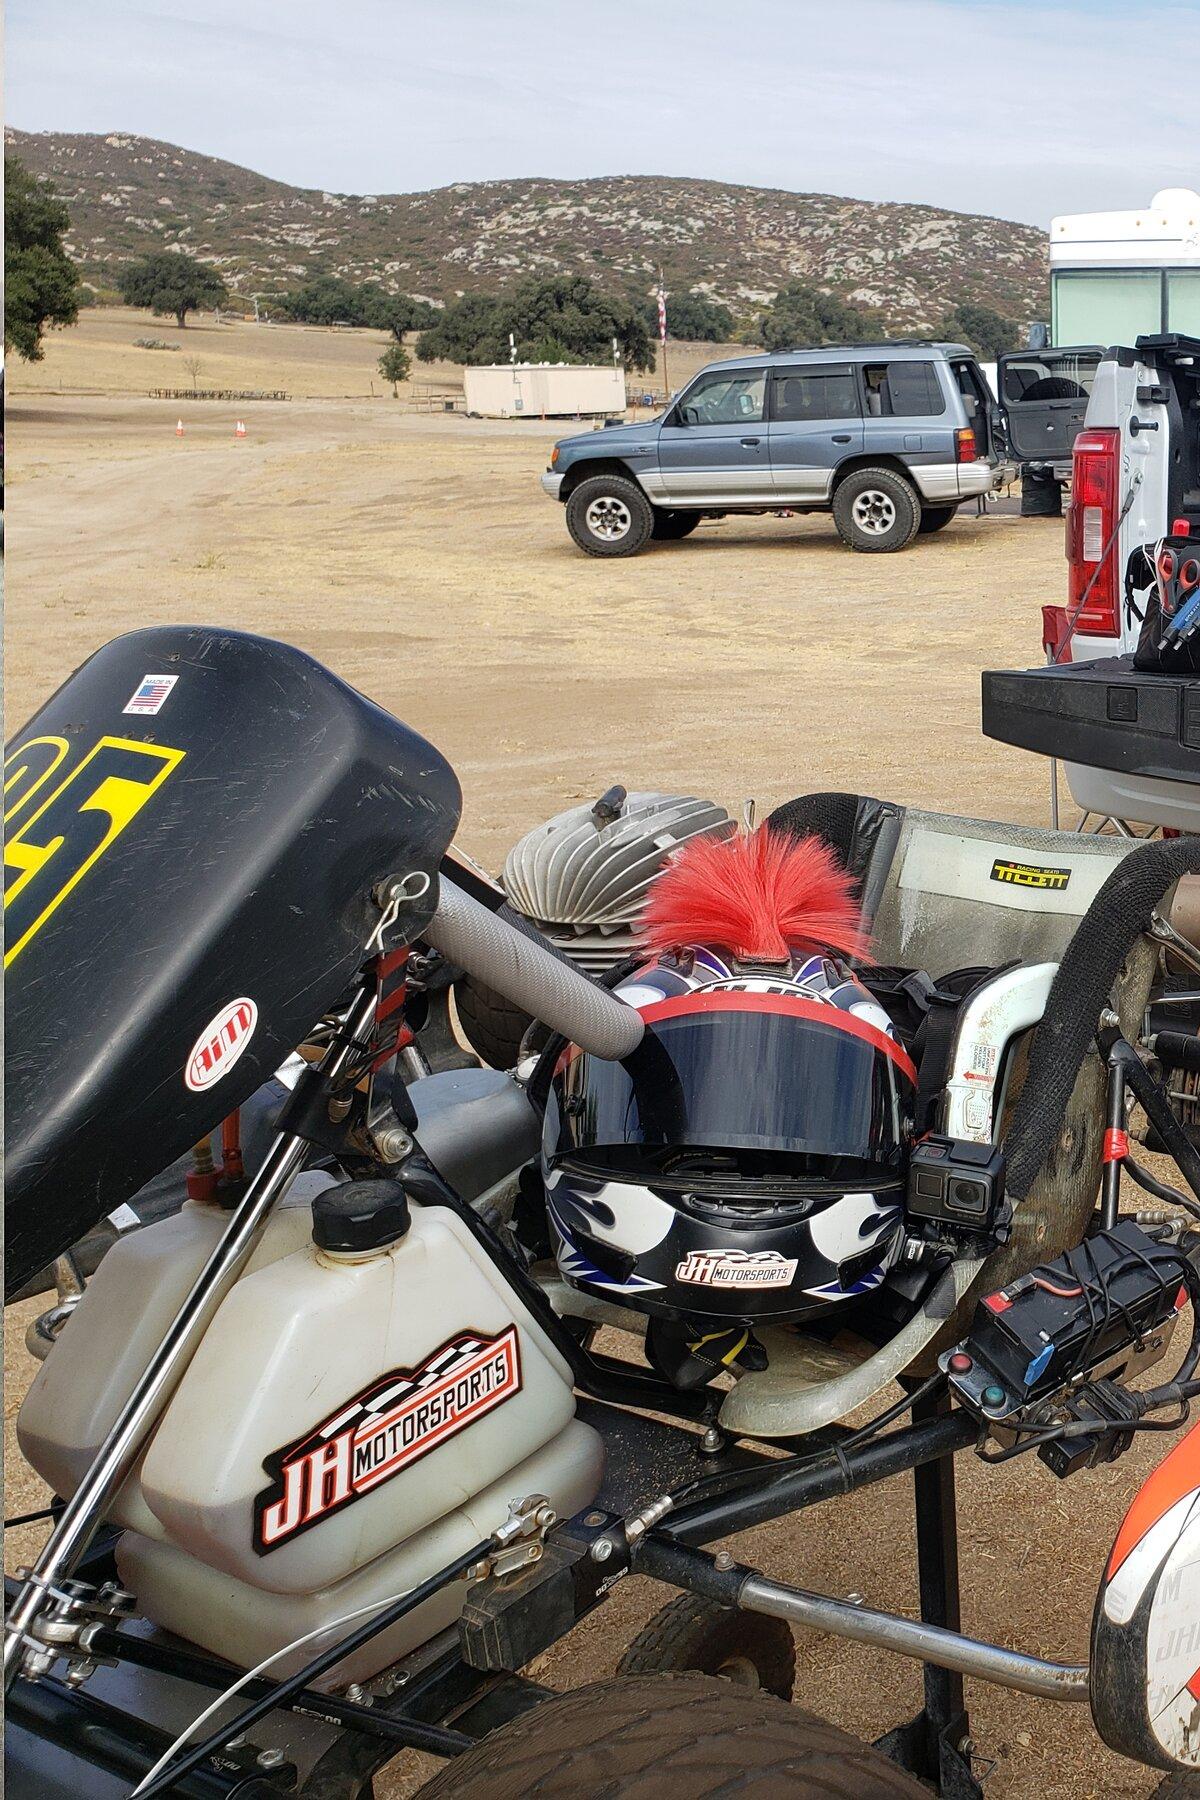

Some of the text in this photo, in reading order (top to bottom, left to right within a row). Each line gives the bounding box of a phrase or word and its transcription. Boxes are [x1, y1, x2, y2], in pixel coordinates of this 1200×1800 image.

[4, 736, 187, 970] 5
[713, 1267, 789, 1281] MOTORSPORTS
[262, 1353, 505, 1547] JH MOTORSPORTS
